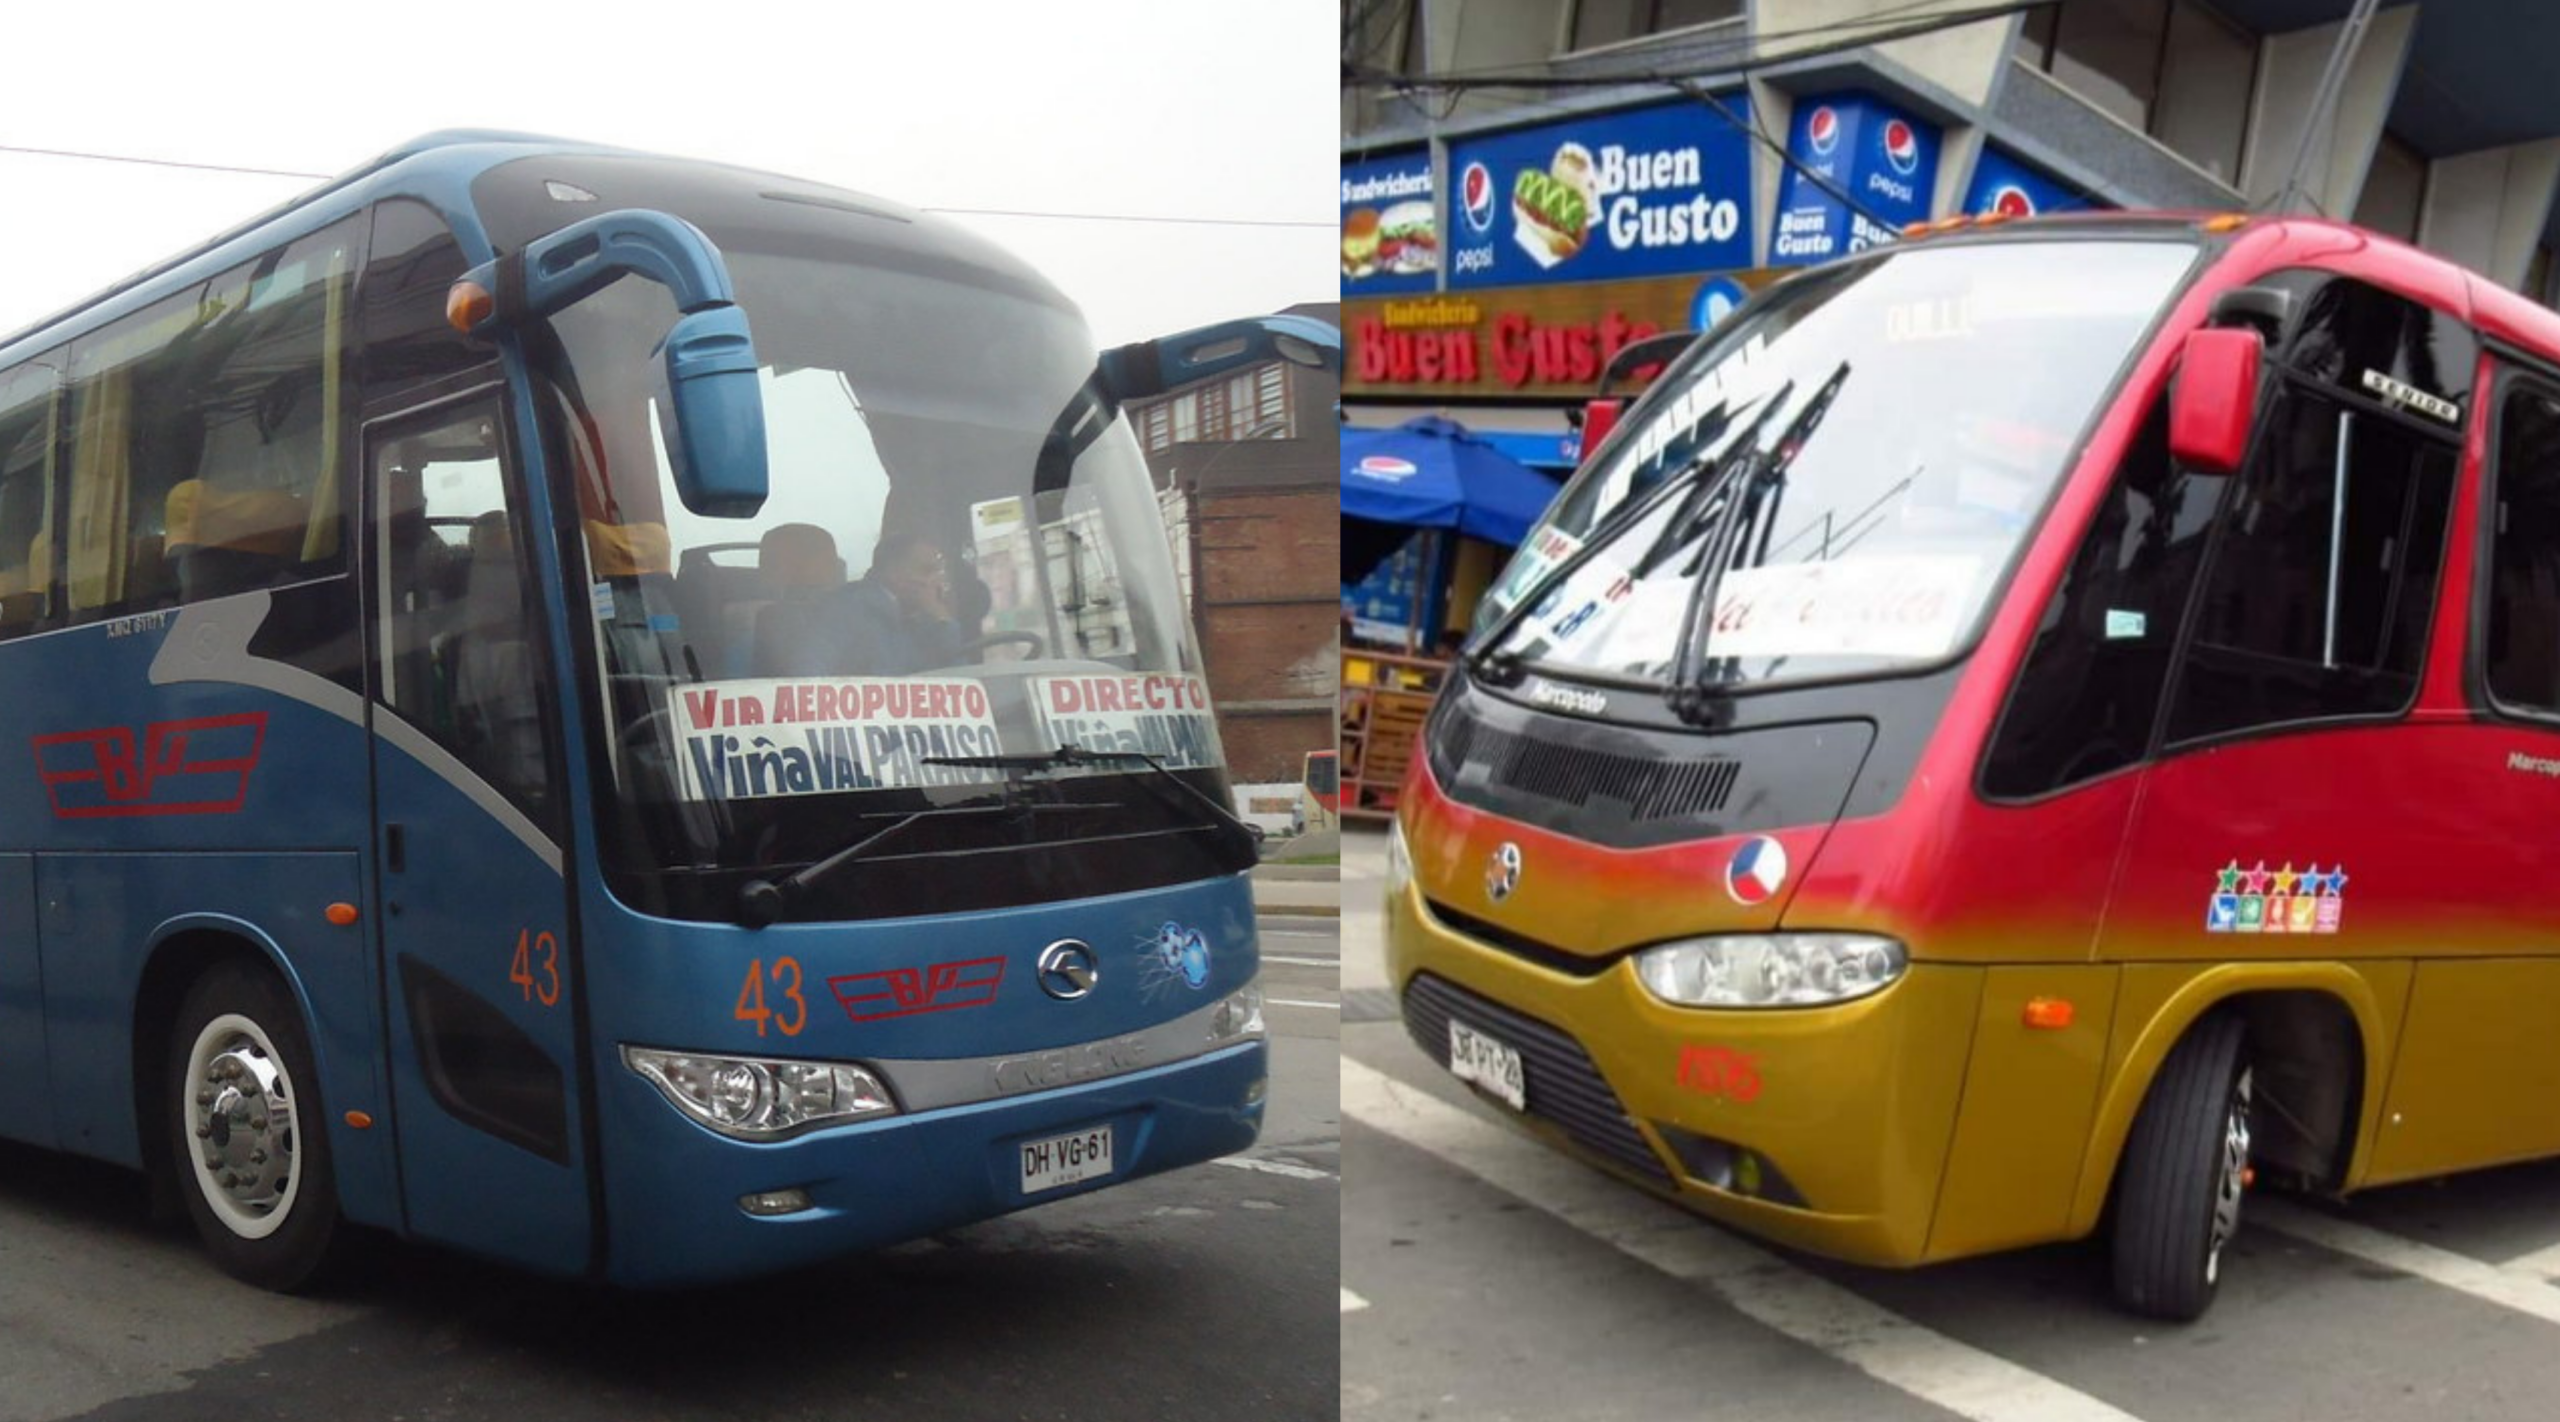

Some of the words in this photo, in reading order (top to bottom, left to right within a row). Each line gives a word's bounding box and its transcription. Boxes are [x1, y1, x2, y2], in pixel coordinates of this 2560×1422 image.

[1599, 145, 1700, 195] Buen
[1869, 173, 1912, 201] pepsi
[1608, 193, 1738, 250] Gusto
[1780, 212, 1825, 233] Buen
[1455, 244, 1494, 275] pepsi
[1777, 232, 1832, 255] Gusto
[1357, 313, 1478, 384] Buen
[1493, 308, 1665, 388] Gusto
[772, 684, 986, 724] AEROPUERTO
[1050, 675, 1206, 714] DIRECTO
[510, 928, 561, 1006] 43
[734, 956, 807, 1037] 43
